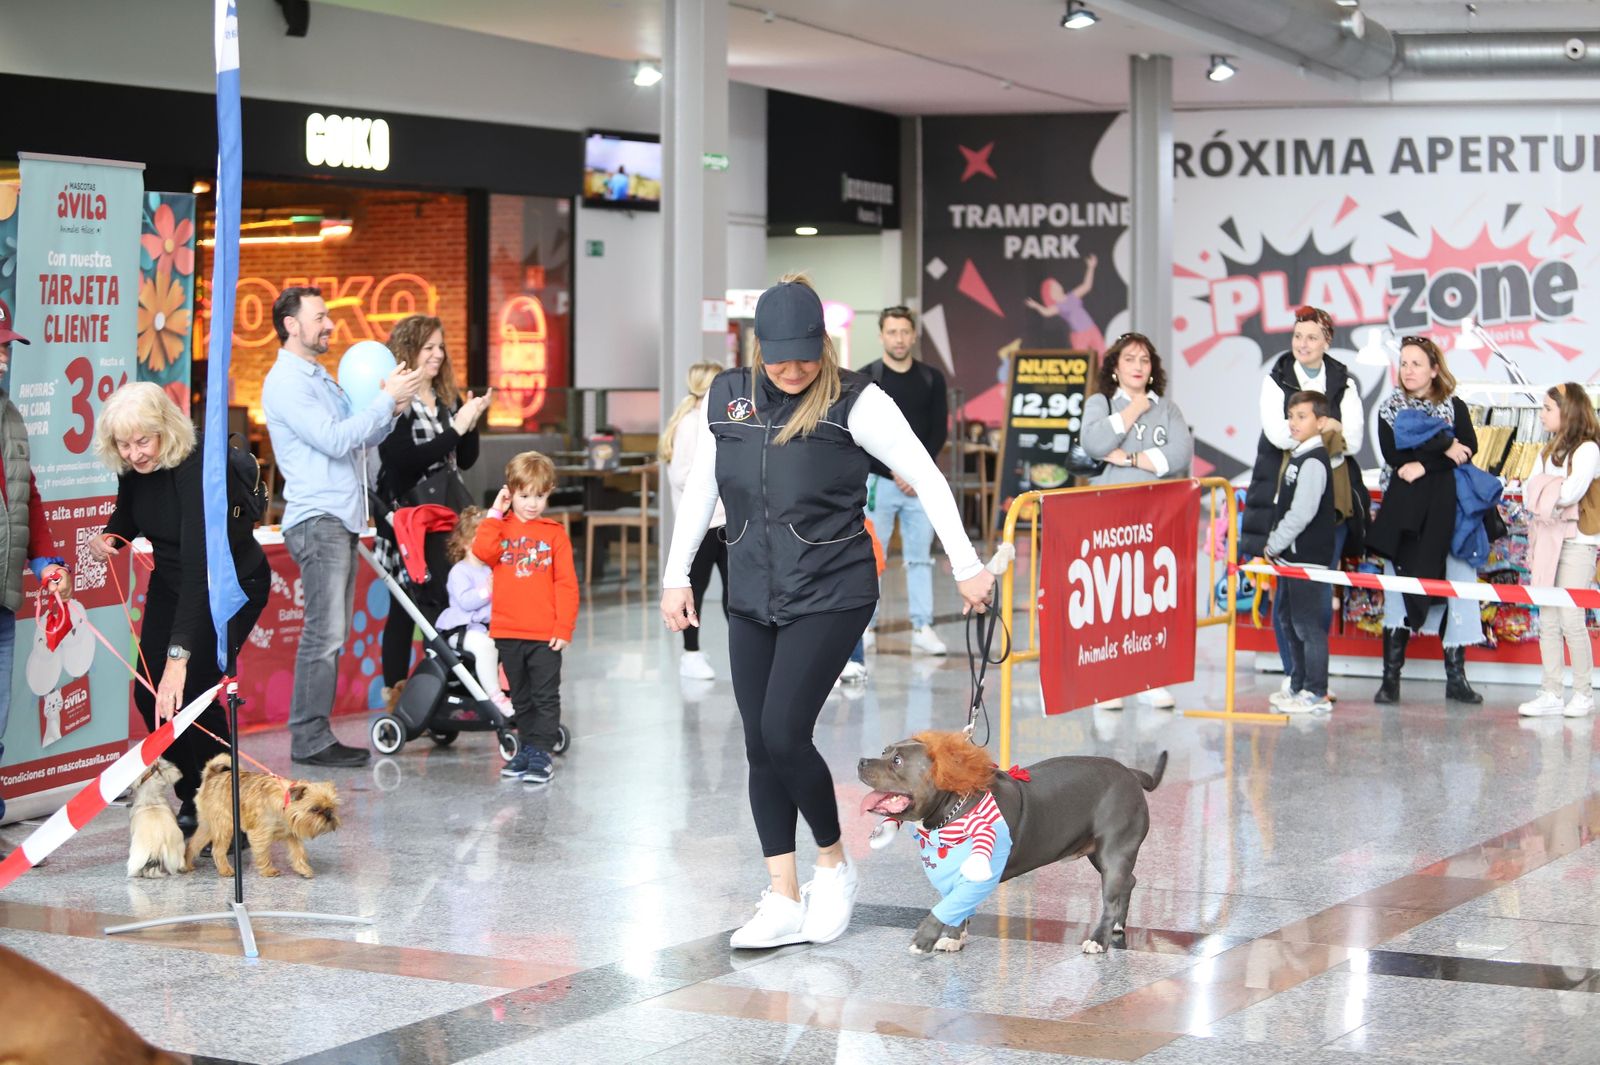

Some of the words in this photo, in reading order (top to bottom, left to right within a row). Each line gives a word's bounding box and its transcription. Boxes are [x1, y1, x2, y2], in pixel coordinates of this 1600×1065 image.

[1173, 130, 1374, 179] RÓXIMA
[69, 182, 96, 191] MASCOTAS
[949, 202, 1131, 228] TRAMPOLINE
[1004, 234, 1080, 259] PARK
[48, 251, 67, 267] Con
[70, 251, 113, 268] nuestra
[39, 274, 119, 306] TARJETA
[44, 314, 110, 343] CLIENTE
[1018, 358, 1087, 376] NUEVO
[30, 401, 51, 417] CADA
[52, 506, 72, 521] alta
[73, 506, 85, 519] en
[86, 505, 97, 517] un
[1093, 522, 1154, 550] MASCOTAS
[1078, 635, 1118, 667] Animales
[1122, 630, 1153, 656] felices
[46, 766, 56, 776] en
